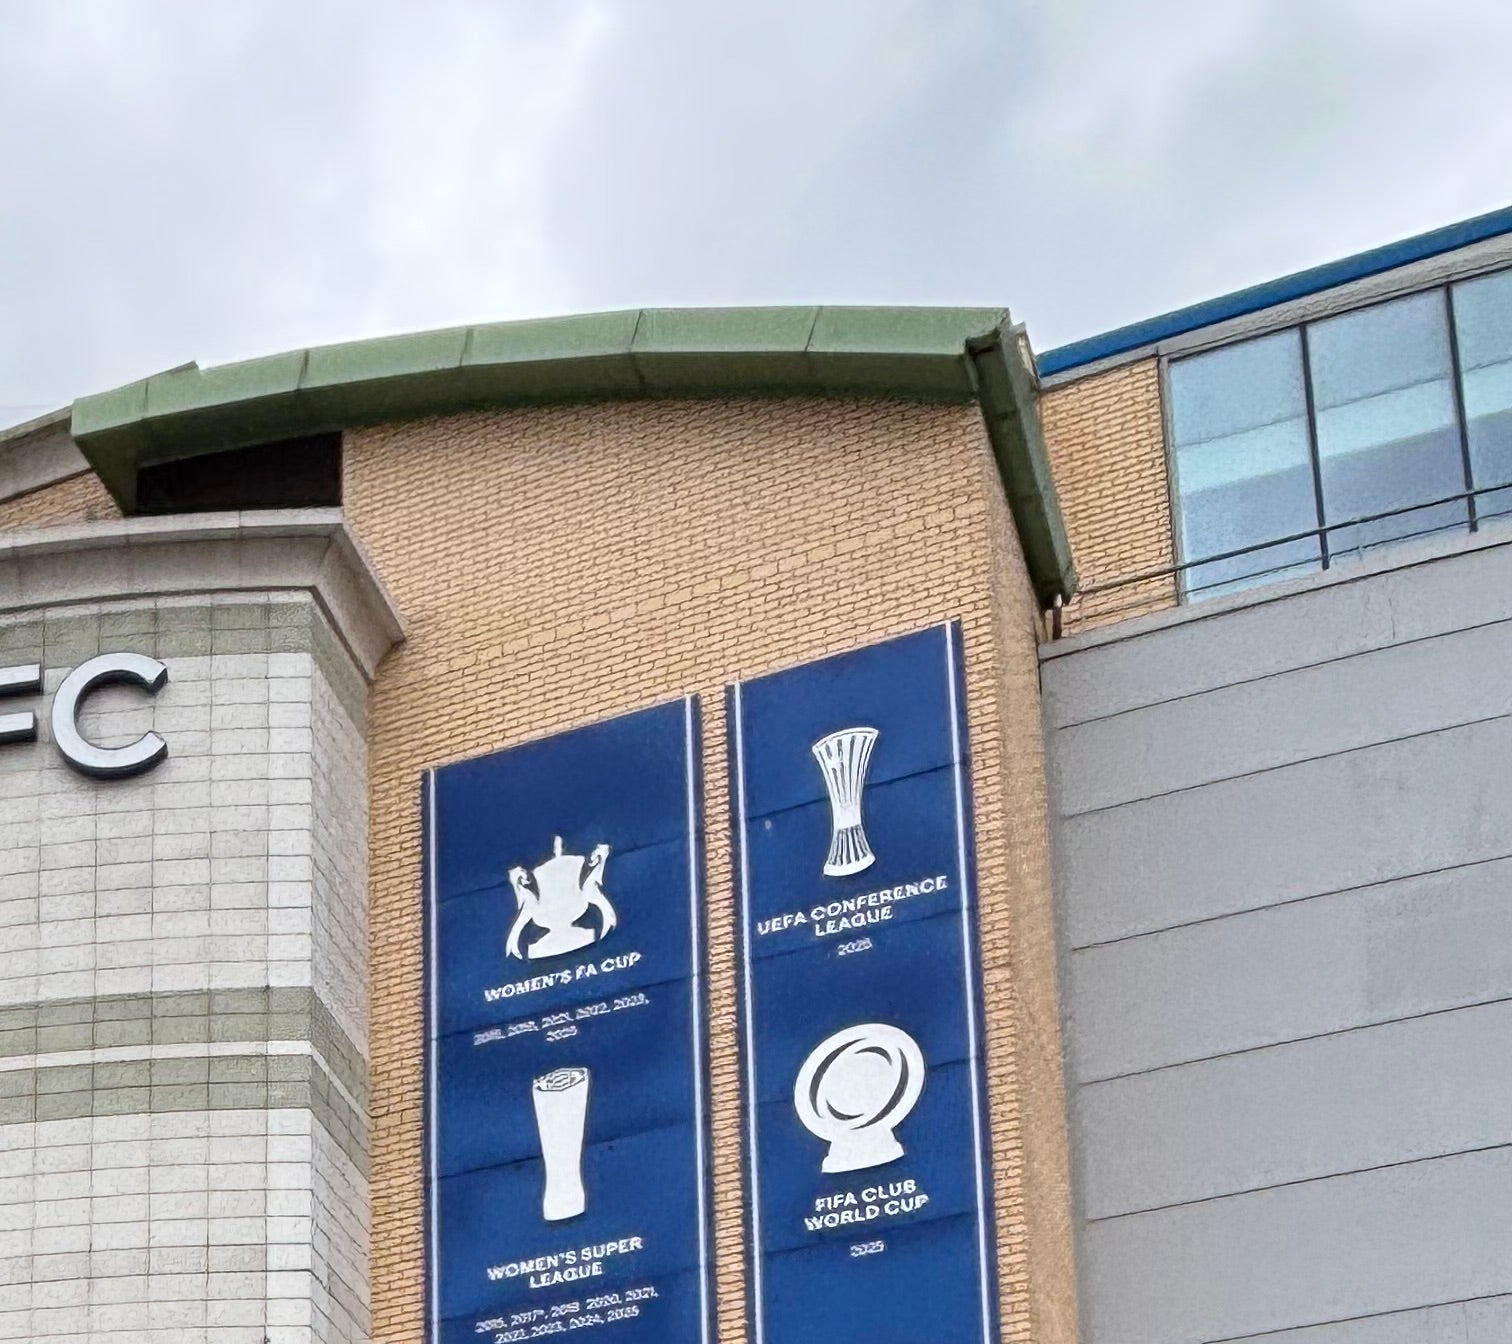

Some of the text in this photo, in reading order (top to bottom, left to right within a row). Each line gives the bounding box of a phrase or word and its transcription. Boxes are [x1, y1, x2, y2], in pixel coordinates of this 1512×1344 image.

[757, 875, 948, 935] UEFA CONFERENCE
[815, 905, 893, 936] LEAGUE
[484, 952, 643, 1002] WOMEN'S FA CUP
[804, 1194, 929, 1231] WORLD CUP
[815, 1179, 916, 1211] FIFA CLUB
[487, 1236, 643, 1281] WOMEN'S SUPER
[529, 1262, 603, 1288] LEAGUE
